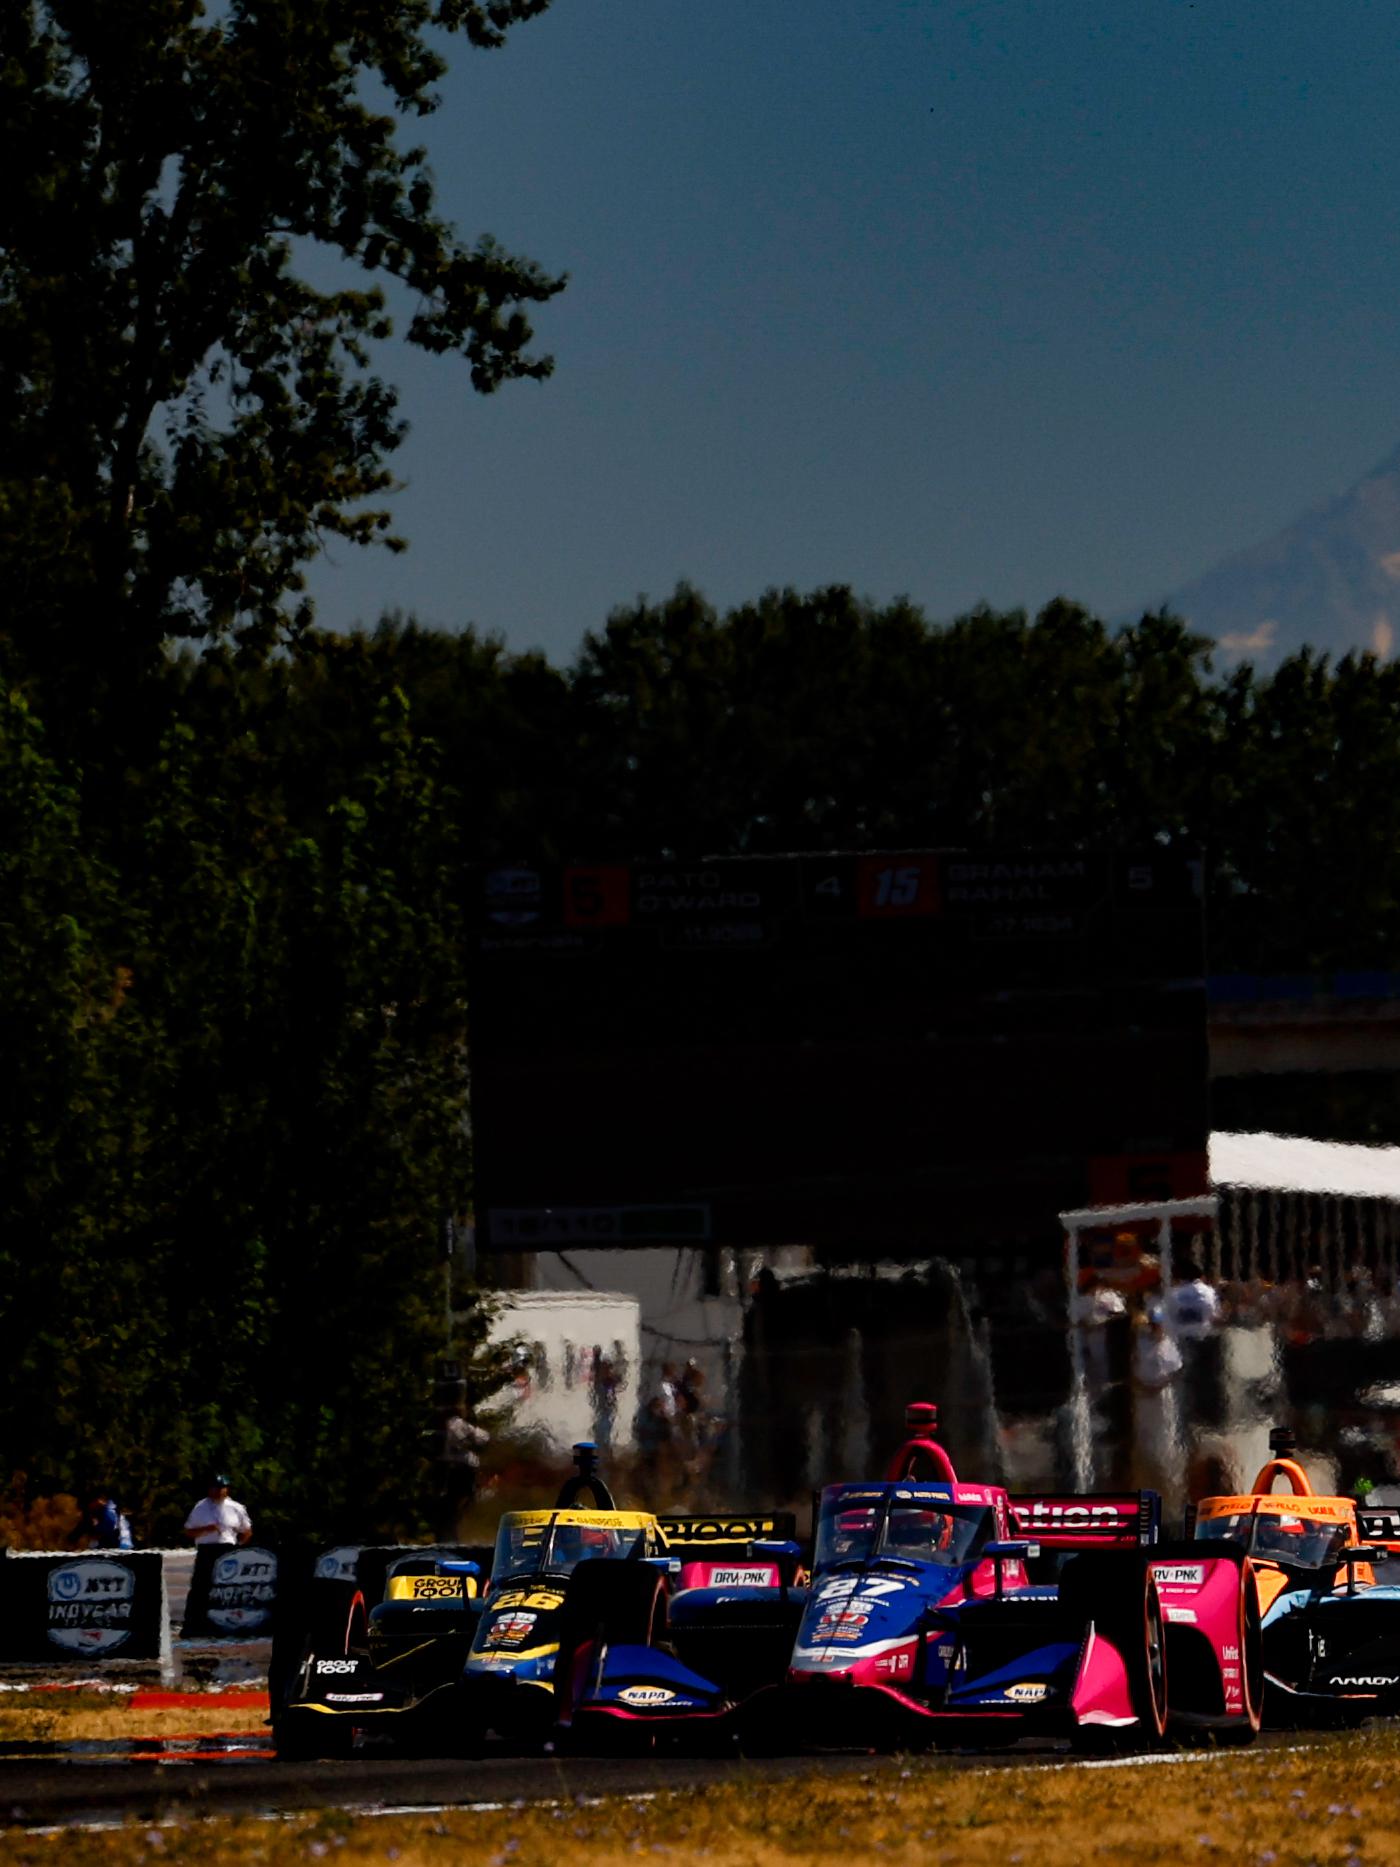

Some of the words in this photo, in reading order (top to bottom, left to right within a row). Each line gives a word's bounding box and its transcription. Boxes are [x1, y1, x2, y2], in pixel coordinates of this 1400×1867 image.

[638, 871, 721, 888] PATO
[815, 876, 842, 896] 4
[873, 867, 922, 908] 15
[240, 1562, 271, 1577] NTT
[1154, 1569, 1169, 1580] RV
[1175, 1569, 1198, 1581] PNK
[714, 1571, 739, 1584] DRV
[743, 1571, 767, 1584] PNK
[84, 1577, 126, 1594] NTT
[414, 1587, 464, 1598] 1001
[316, 1665, 357, 1675] 1001
[628, 1691, 666, 1699] NAPA
